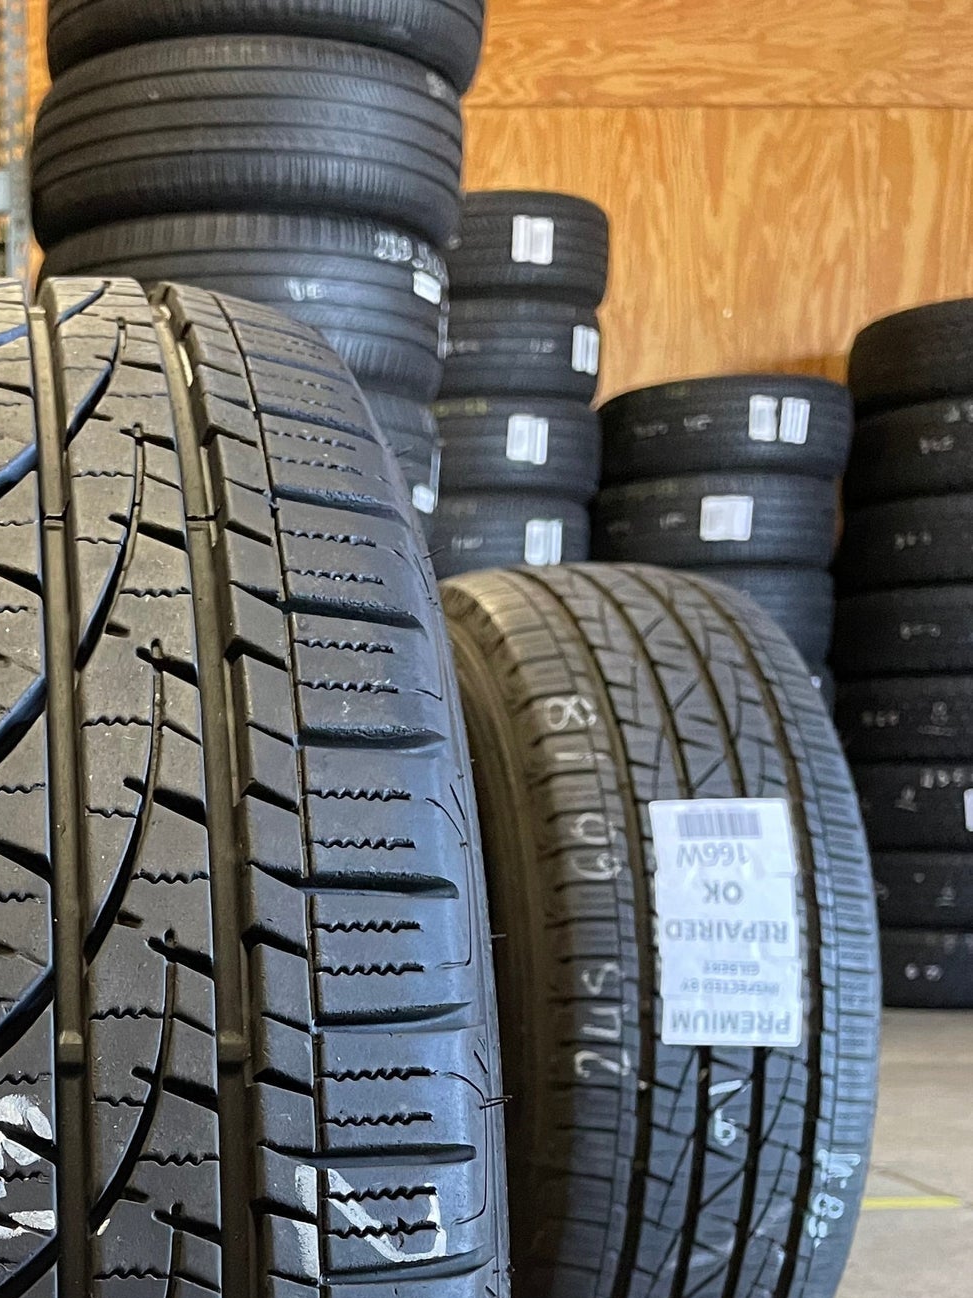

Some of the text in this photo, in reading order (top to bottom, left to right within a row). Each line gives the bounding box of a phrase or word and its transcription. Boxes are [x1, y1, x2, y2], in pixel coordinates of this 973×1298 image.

[704, 880, 743, 905] OK
[665, 919, 788, 943] REPAIRED
[670, 1010, 792, 1035] PREMIUM
